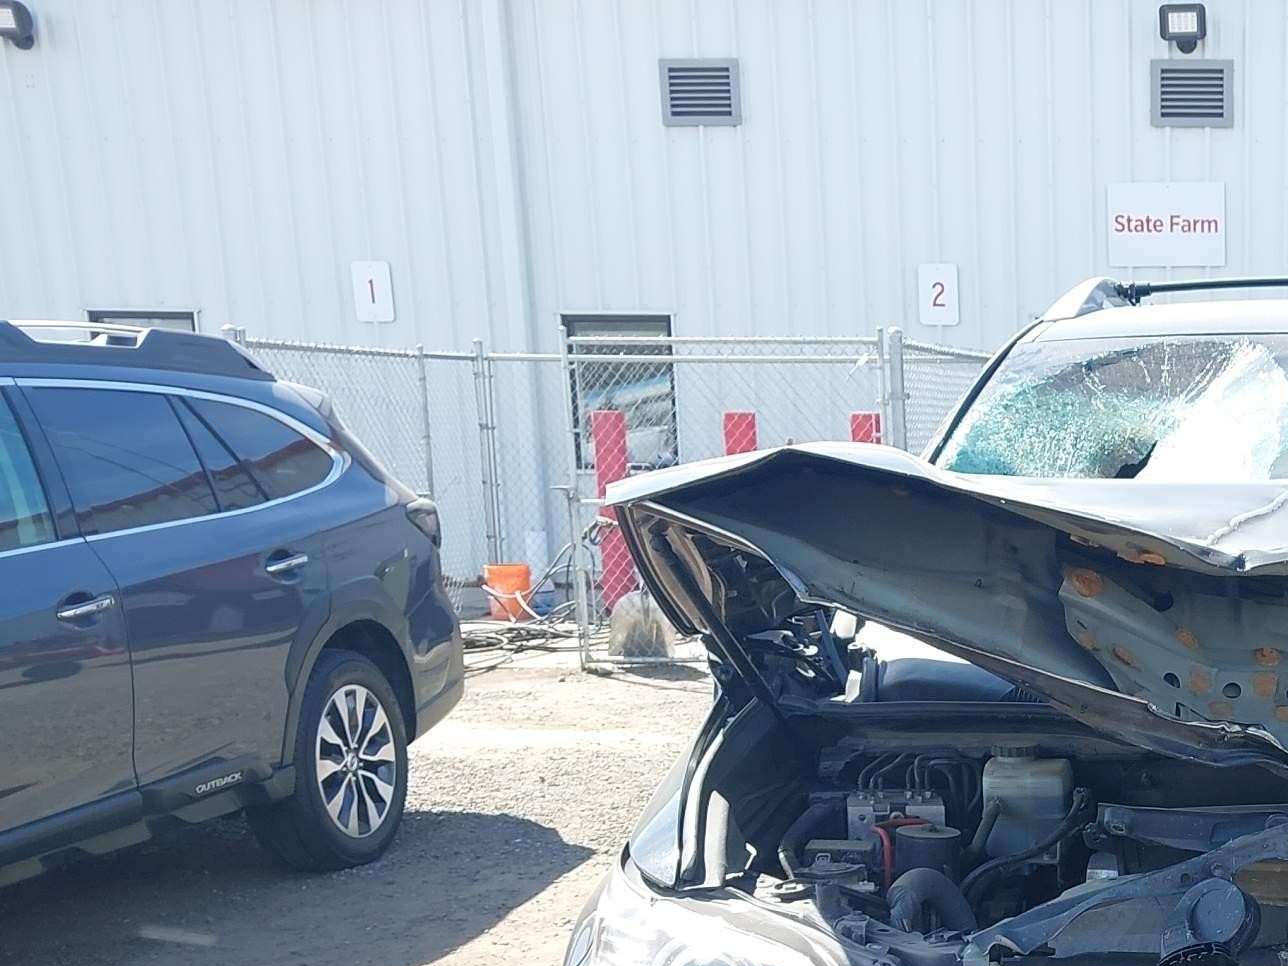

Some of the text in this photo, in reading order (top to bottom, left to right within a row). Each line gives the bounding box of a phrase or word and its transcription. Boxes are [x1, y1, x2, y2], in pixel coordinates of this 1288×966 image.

[1114, 214, 1219, 233] State Farm
[367, 278, 376, 305] 1
[932, 281, 946, 307] 2
[195, 771, 243, 794] OUTBACK
